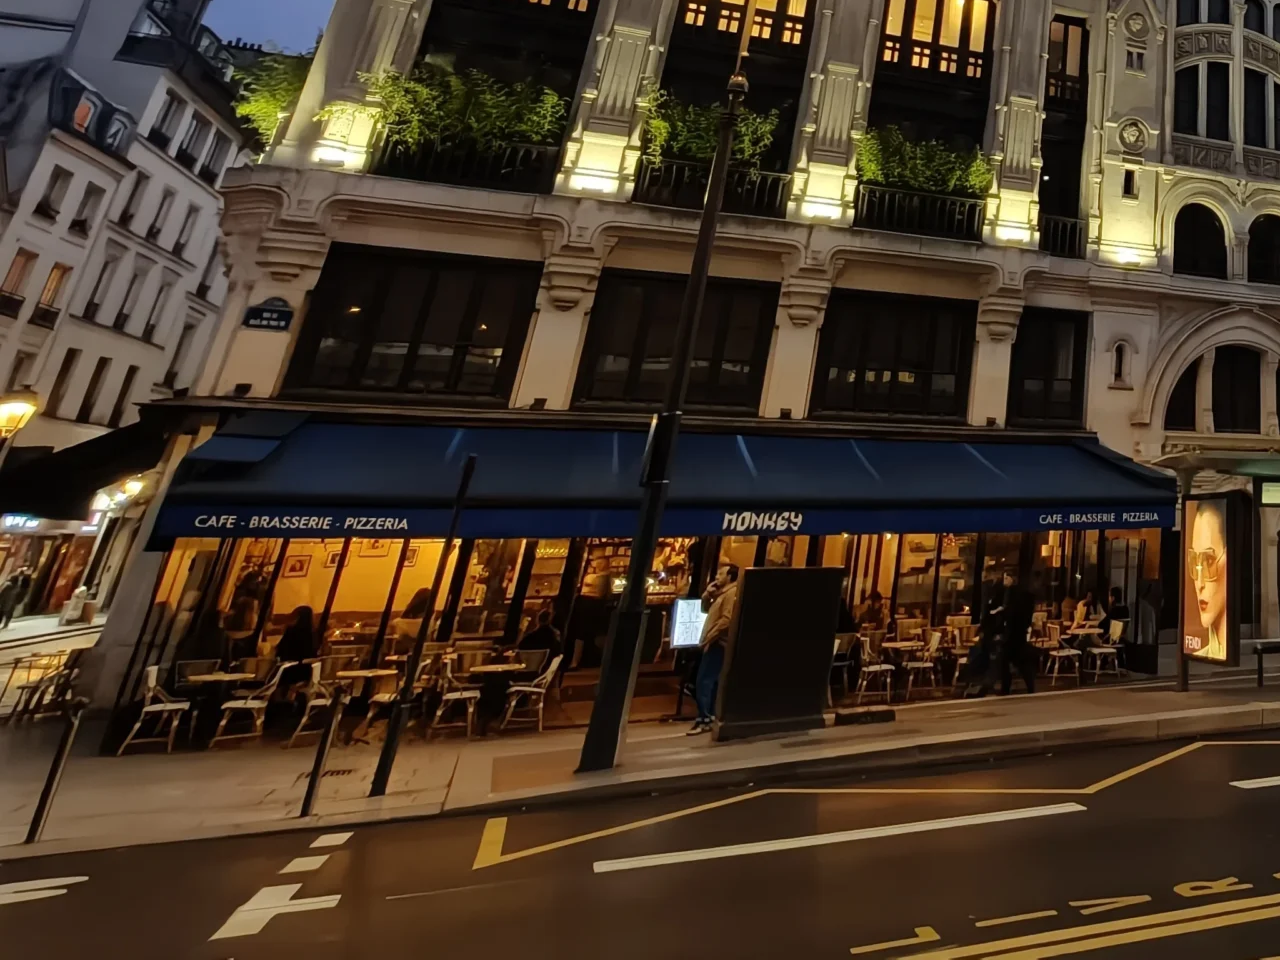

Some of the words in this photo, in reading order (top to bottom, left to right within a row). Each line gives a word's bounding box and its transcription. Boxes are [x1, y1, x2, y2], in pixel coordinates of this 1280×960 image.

[194, 515, 237, 528] CAFE
[249, 516, 332, 529] BRASSERIE
[343, 517, 408, 530] PIZZERIA
[722, 511, 803, 531] MONKEY
[1039, 514, 1062, 524] CAFE
[1069, 513, 1115, 524] BRASSERIE
[1122, 512, 1159, 522] PIZZERIA
[1185, 635, 1202, 650] FENDI
